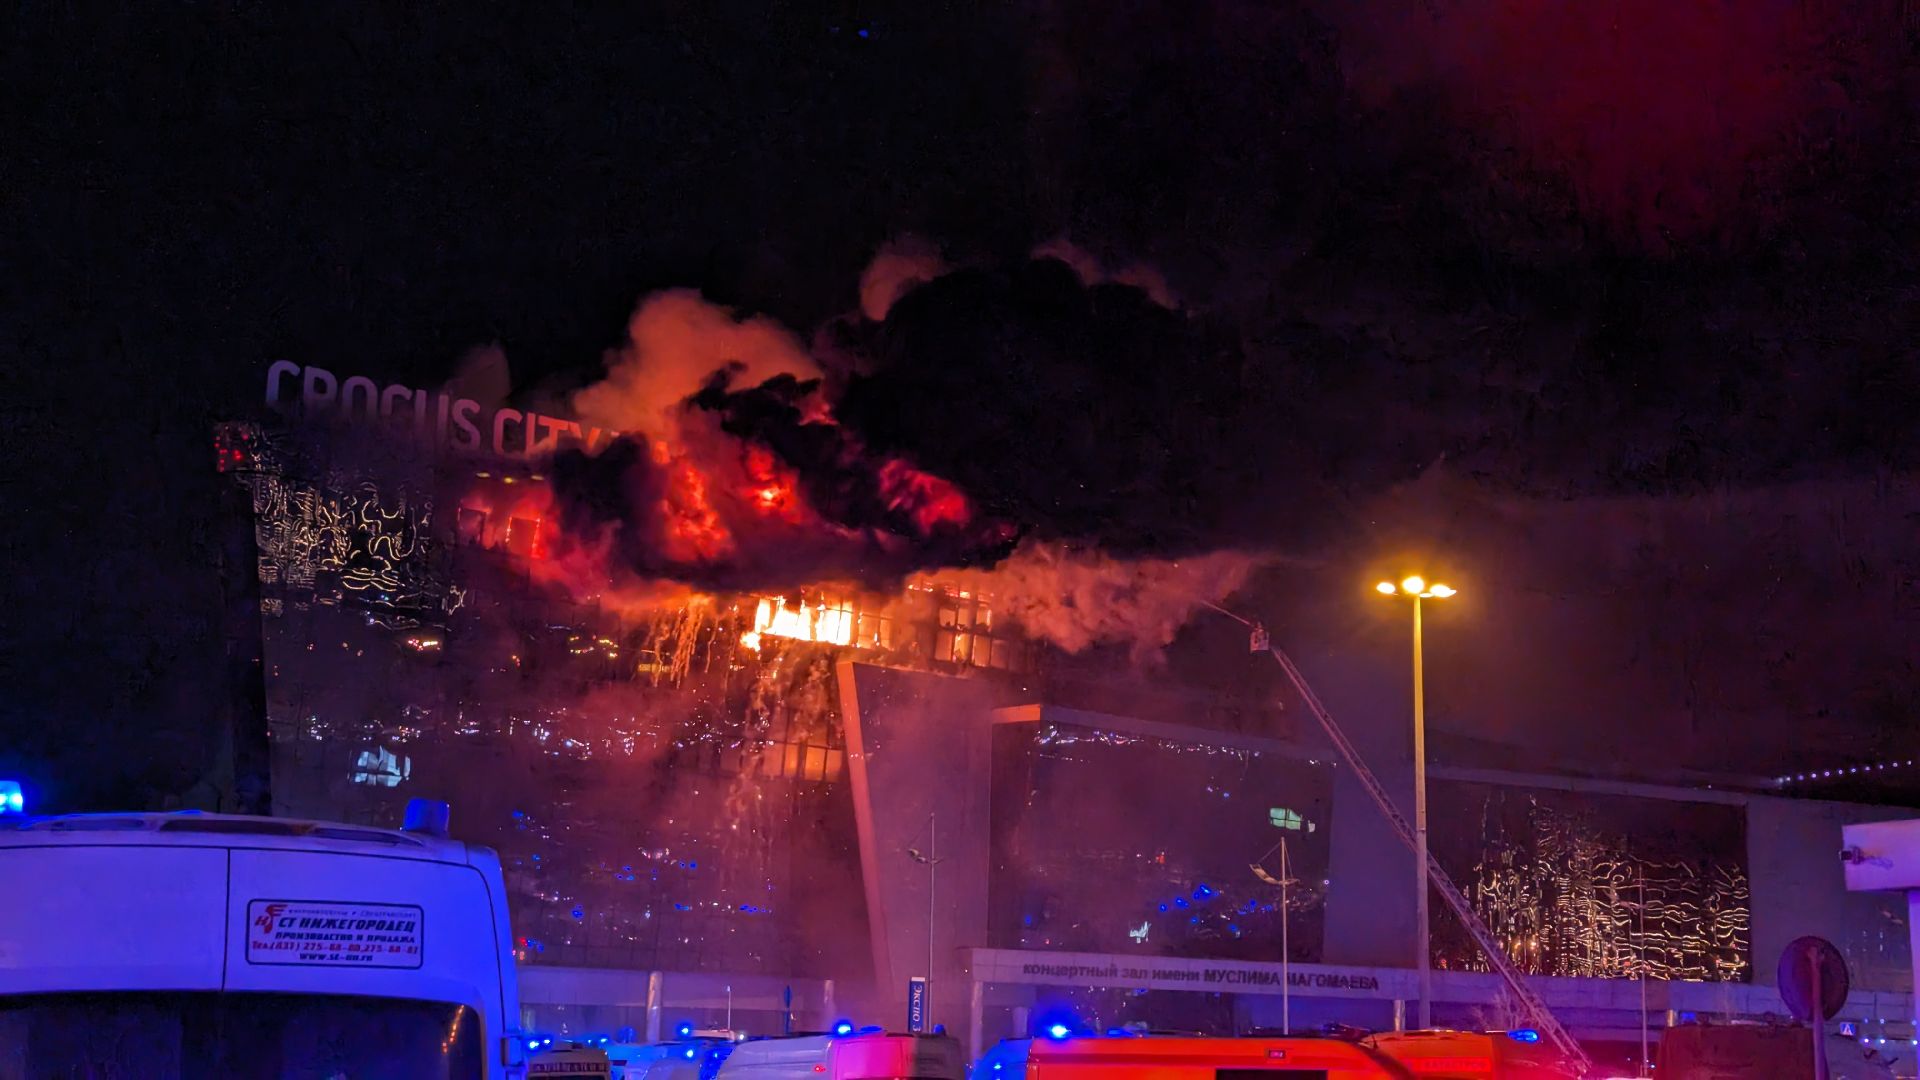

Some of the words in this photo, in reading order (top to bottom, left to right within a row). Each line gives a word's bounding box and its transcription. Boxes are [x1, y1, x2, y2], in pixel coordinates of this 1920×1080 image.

[266, 360, 482, 450] CROCUS
[278, 916, 296, 928] СТ
[300, 918, 416, 933] НИЖЕГОРОДЕЦ
[1023, 963, 1118, 979] концертный
[1121, 969, 1148, 980] зал
[1152, 968, 1200, 981] имени
[1204, 969, 1280, 986] МУСЛИМА
[1286, 972, 1379, 990] МАГОМАЕВА
